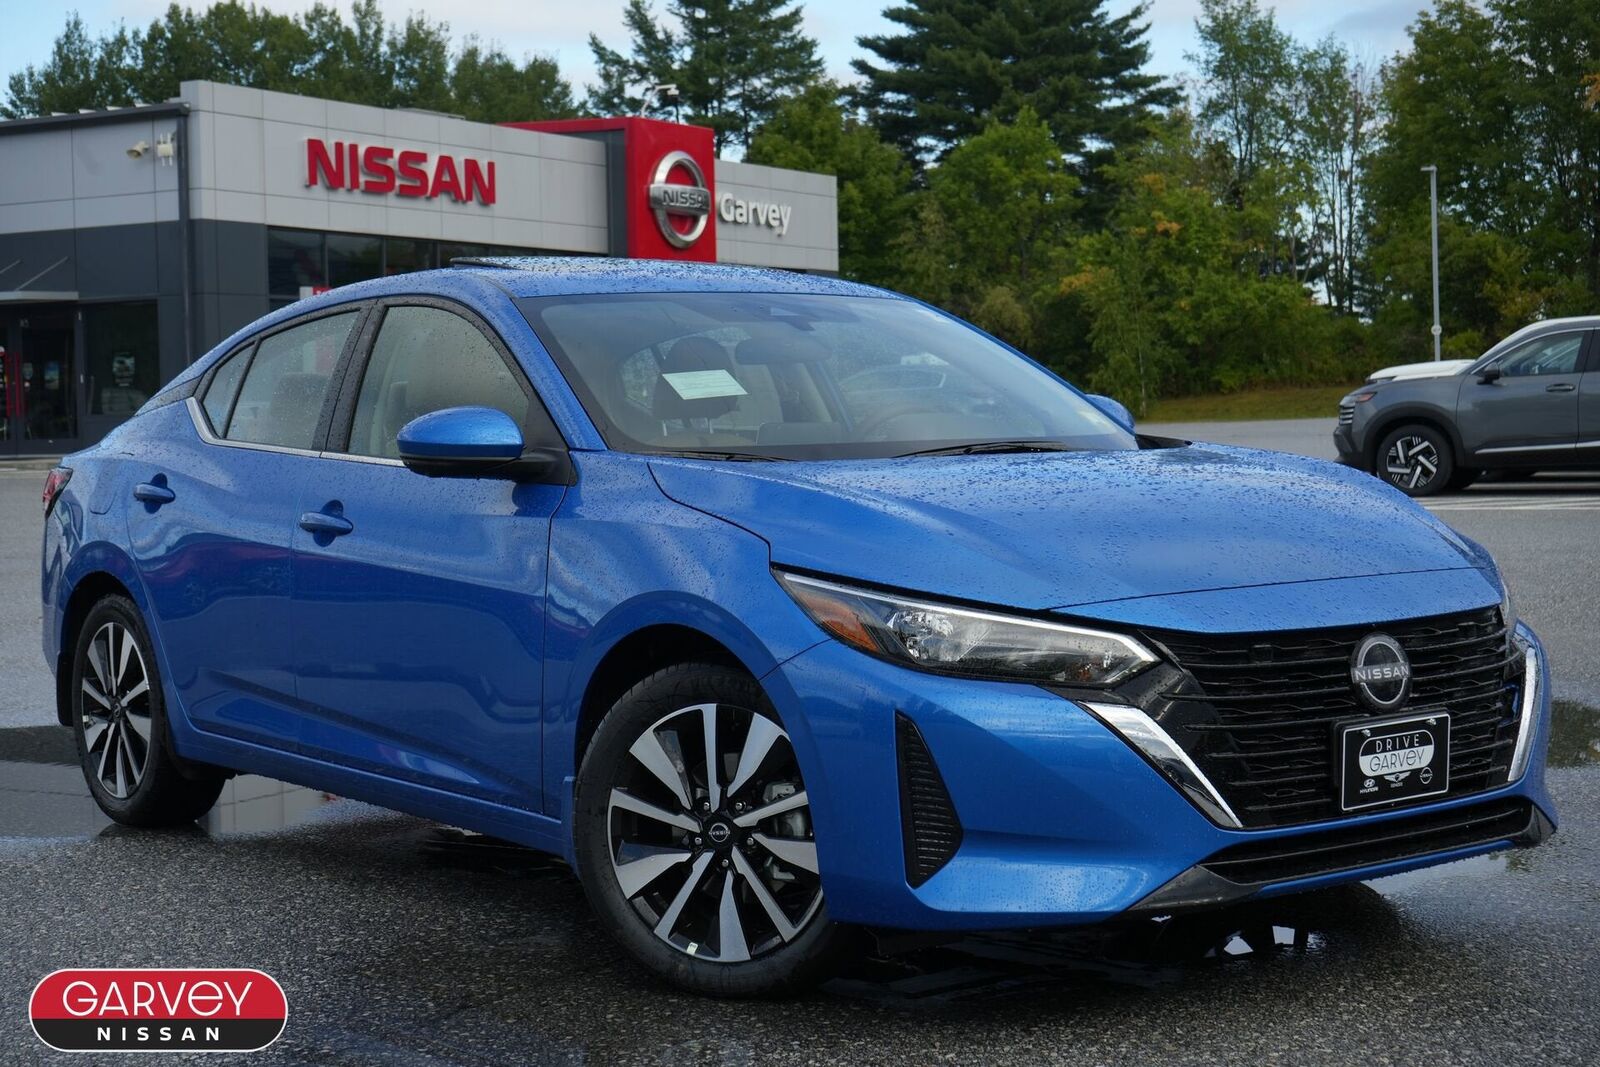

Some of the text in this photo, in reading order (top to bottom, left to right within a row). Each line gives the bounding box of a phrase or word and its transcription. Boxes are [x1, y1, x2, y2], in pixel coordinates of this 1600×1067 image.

[307, 138, 496, 205] NISSAN
[720, 193, 792, 235] Garvey
[1354, 665, 1409, 681] NISSAN
[1375, 734, 1420, 753] DRIVE
